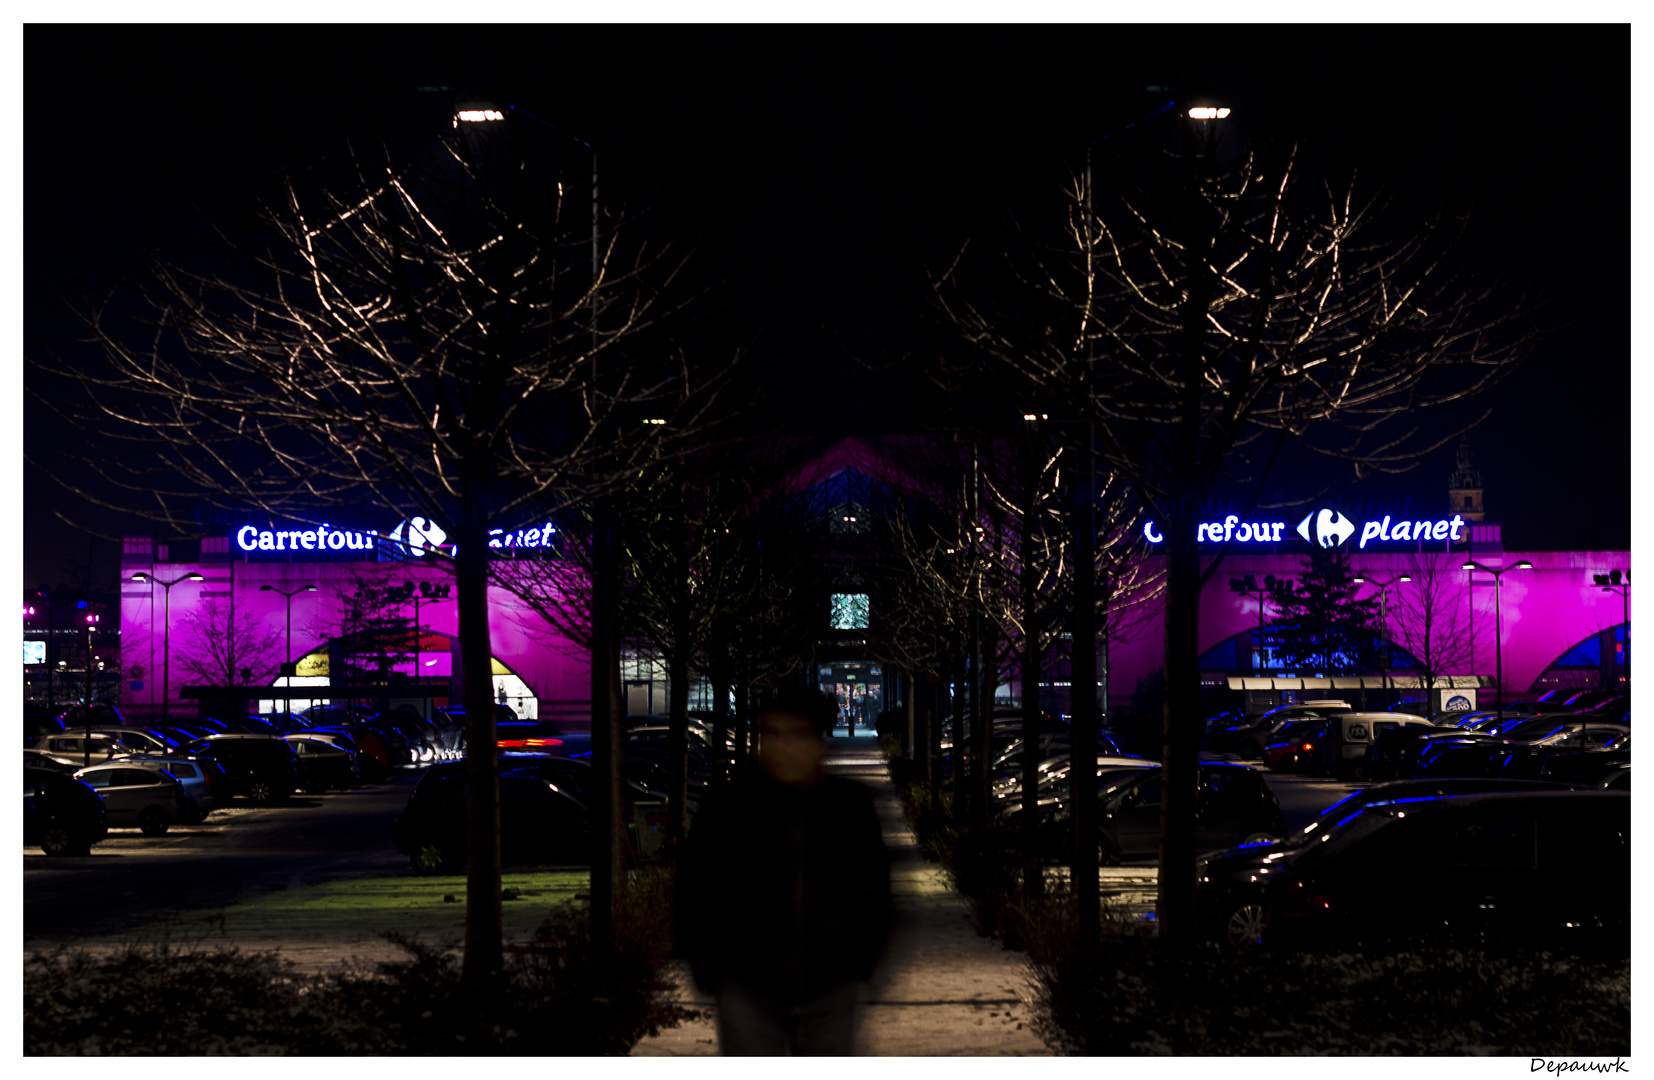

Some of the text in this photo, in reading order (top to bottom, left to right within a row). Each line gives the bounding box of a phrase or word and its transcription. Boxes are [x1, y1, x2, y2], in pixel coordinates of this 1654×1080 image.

[237, 523, 378, 551] Carrefour
[1143, 514, 1465, 549] Crefour planet
